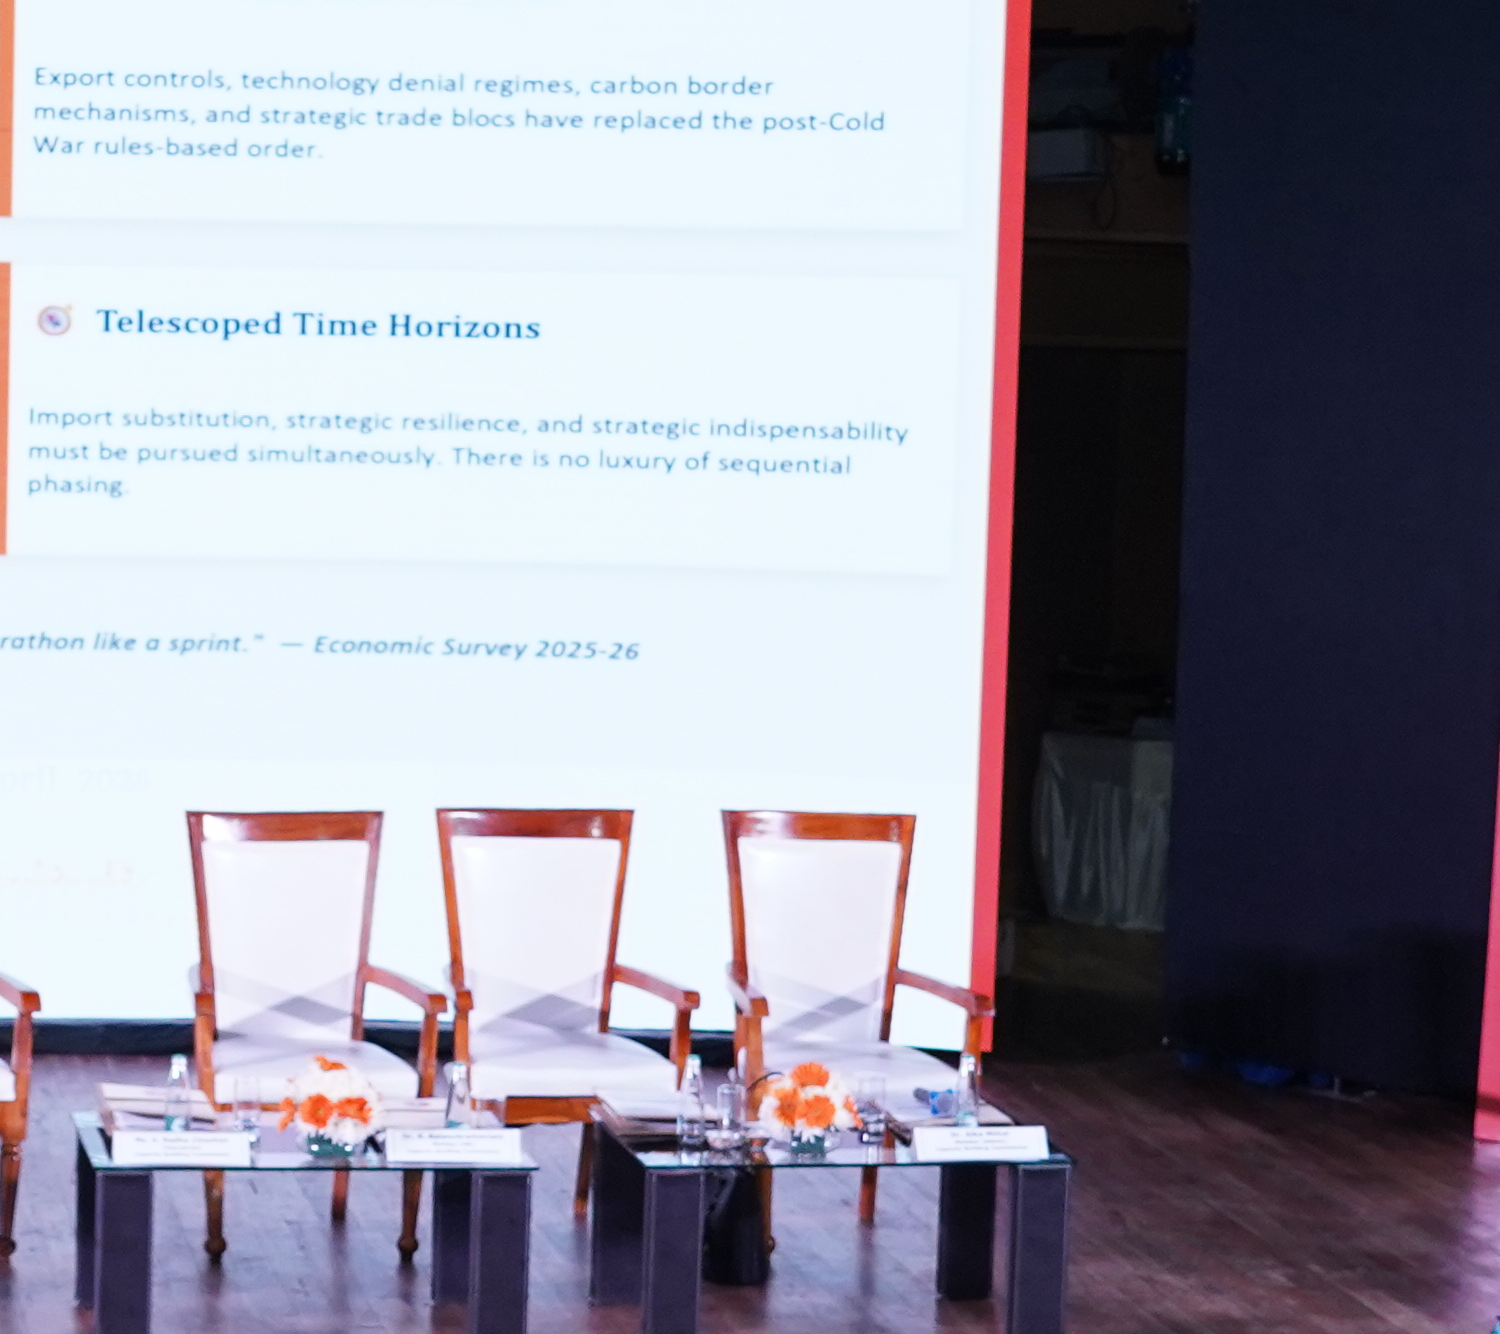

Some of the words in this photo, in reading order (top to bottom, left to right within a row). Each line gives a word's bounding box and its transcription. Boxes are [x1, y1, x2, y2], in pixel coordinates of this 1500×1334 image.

[33, 65, 117, 90] Export
[122, 69, 233, 92] controls,
[239, 70, 381, 97] technology
[386, 71, 466, 94] denial
[472, 77, 582, 99] regimes,
[588, 75, 680, 96] carbon
[686, 74, 775, 97] border
[32, 101, 197, 125] mechanisms,
[204, 103, 253, 125] and
[258, 107, 368, 131] strategic
[374, 107, 444, 128] trade
[450, 106, 517, 129] blocs
[523, 108, 586, 130] have
[592, 109, 704, 133] replaced
[710, 109, 755, 132] the
[761, 110, 886, 135] post-Cold
[31, 134, 86, 156] War
[92, 135, 240, 159] rules-based
[245, 138, 323, 160] order.
[95, 308, 283, 341] Telescoped
[291, 311, 379, 338] Time
[388, 312, 542, 340] Horizons
[28, 407, 114, 430] Import
[120, 408, 278, 431] substitution,
[285, 412, 394, 436] strategic
[400, 412, 529, 435] resilience,
[535, 413, 585, 435] and
[590, 417, 702, 442] strategic
[708, 418, 910, 445] indispensability
[27, 443, 91, 462] must
[97, 440, 130, 462] be
[135, 443, 240, 465] pursued
[246, 444, 442, 468] simultaneously.
[450, 445, 525, 468] There
[531, 449, 551, 469] is
[557, 452, 592, 470] no
[597, 448, 678, 475] luxury
[683, 449, 713, 472] of
[717, 455, 853, 476] sequential
[26, 474, 130, 500] phasing.
[91, 631, 139, 653] like
[143, 636, 162, 653] a
[167, 633, 266, 656] sprint."
[312, 634, 436, 656] Economic
[440, 636, 530, 662] Survey
[533, 638, 641, 662] 2025-26
